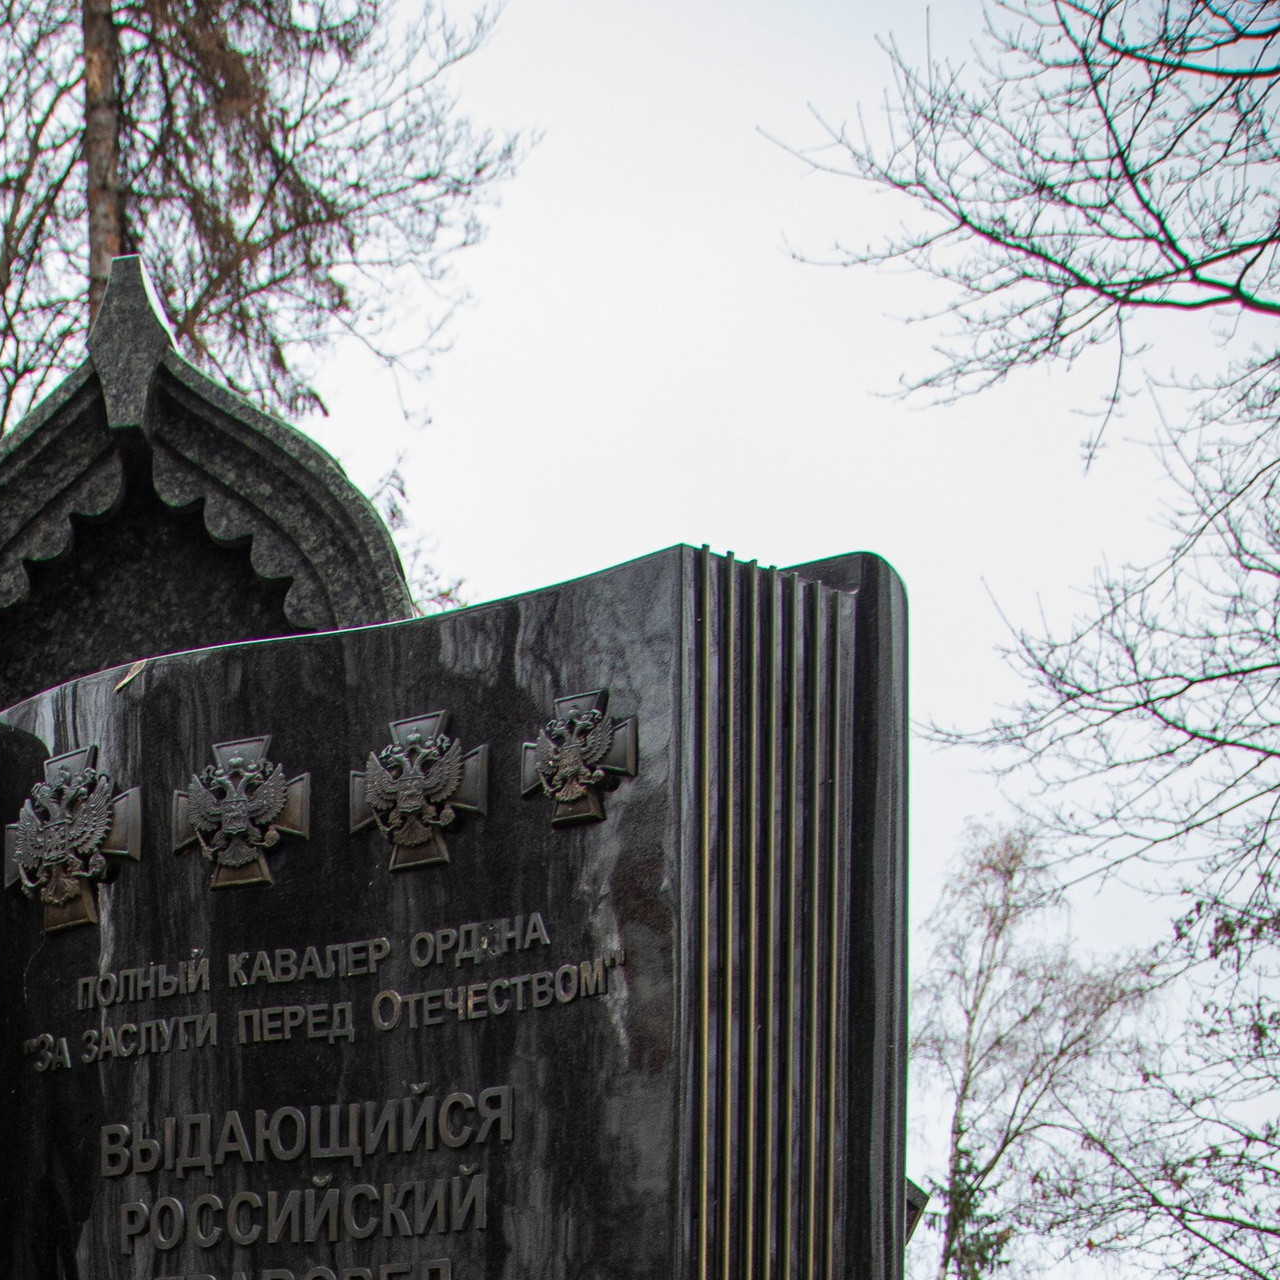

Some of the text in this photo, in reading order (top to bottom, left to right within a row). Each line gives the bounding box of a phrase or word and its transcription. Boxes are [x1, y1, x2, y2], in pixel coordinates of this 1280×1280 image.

[77, 912, 551, 1010] ПОЛНЫЙ КАВАЛЕР ОРДНА
[81, 1013, 217, 1064] ЗАСЛУГИ
[237, 1002, 355, 1045] ПЕРЕД
[100, 1082, 514, 1179] ВЫДАЮЩИЙСЯ
[120, 1164, 487, 1255] РОССИЙСКИЙ
